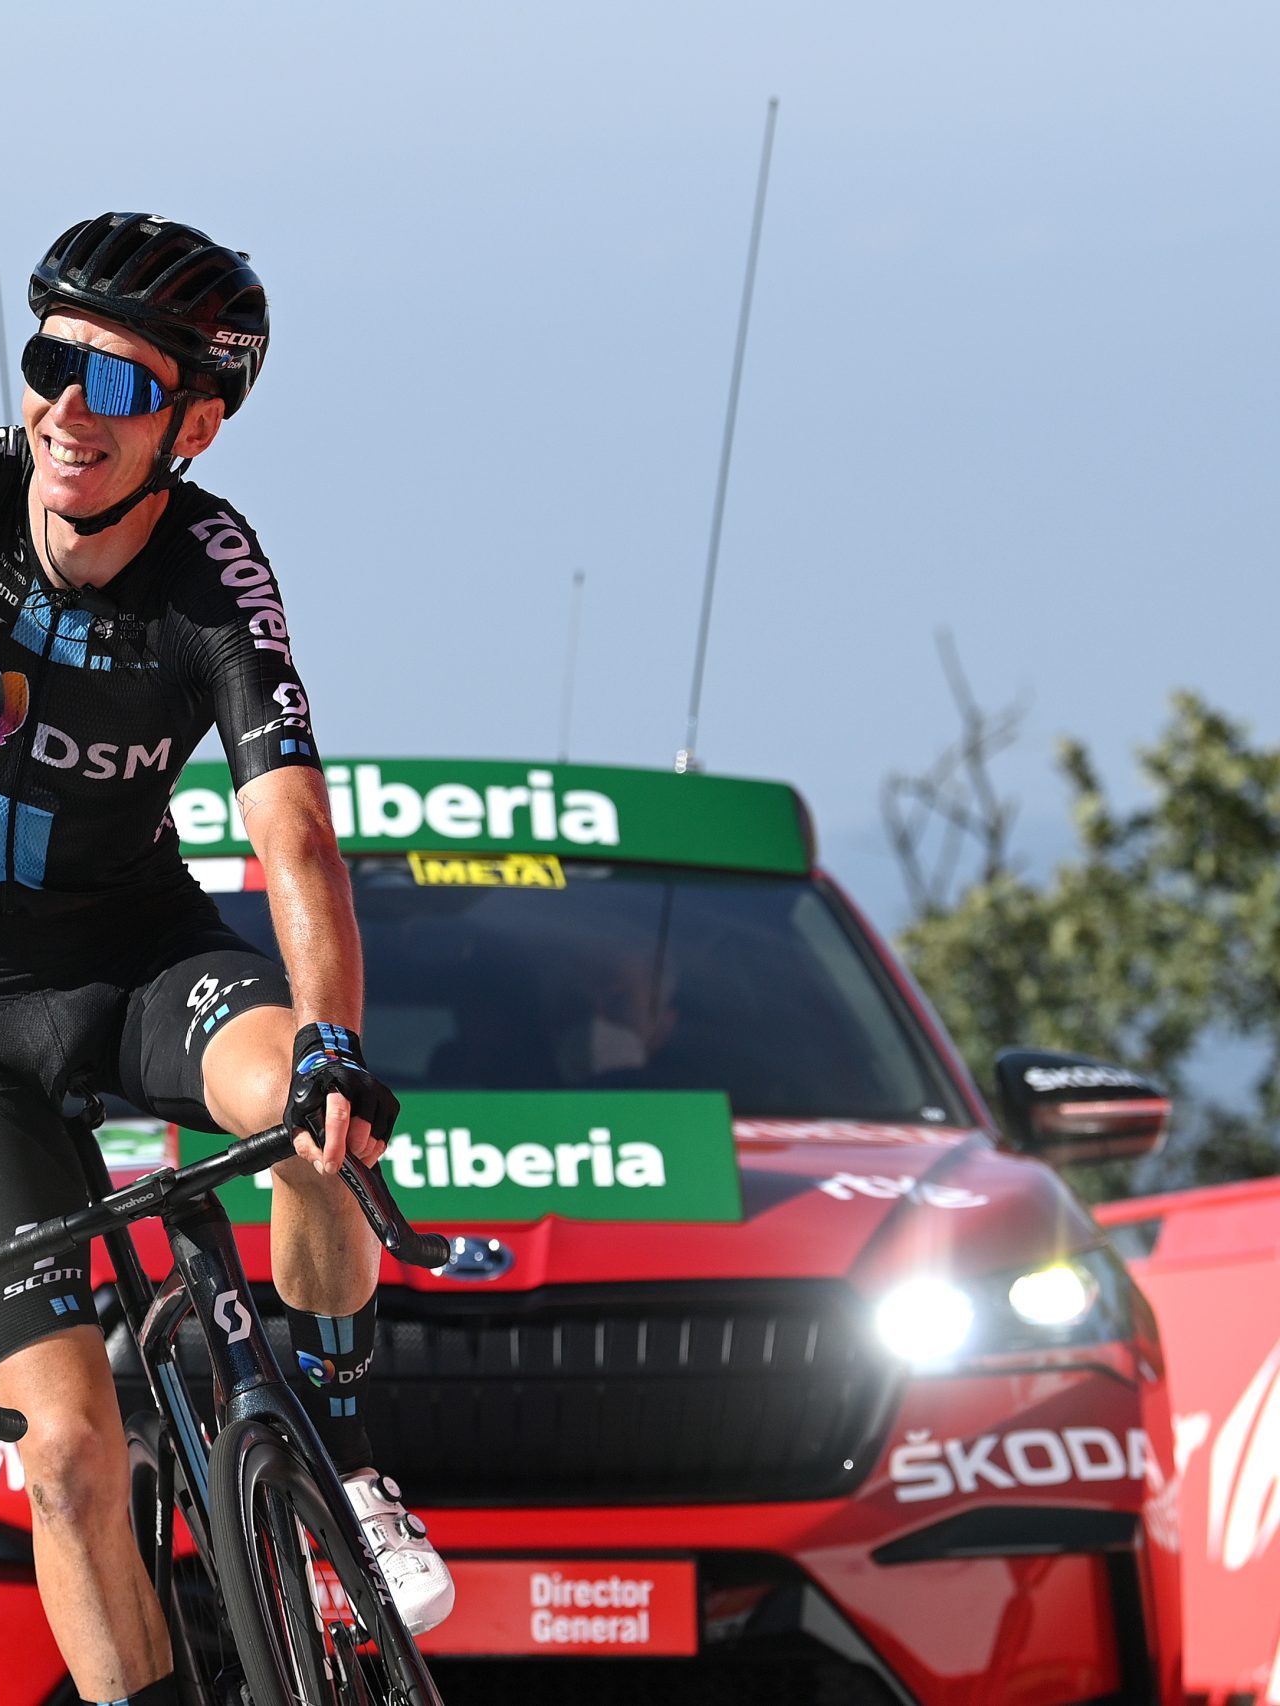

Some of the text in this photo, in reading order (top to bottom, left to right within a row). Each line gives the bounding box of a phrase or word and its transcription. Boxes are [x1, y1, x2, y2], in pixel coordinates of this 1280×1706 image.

[208, 346, 230, 357] TEAM
[212, 331, 266, 347] SCOTT
[187, 511, 291, 666] zoover
[119, 613, 136, 621] UCI
[31, 722, 172, 780] DSM
[423, 857, 554, 889] META
[185, 977, 261, 1056] SCOTT
[113, 1192, 155, 1212] wahoo
[3, 1267, 84, 1301] SCOTT
[889, 1428, 1166, 1503] ŠKODA
[530, 1571, 653, 1608] Director
[530, 1608, 650, 1644] General
